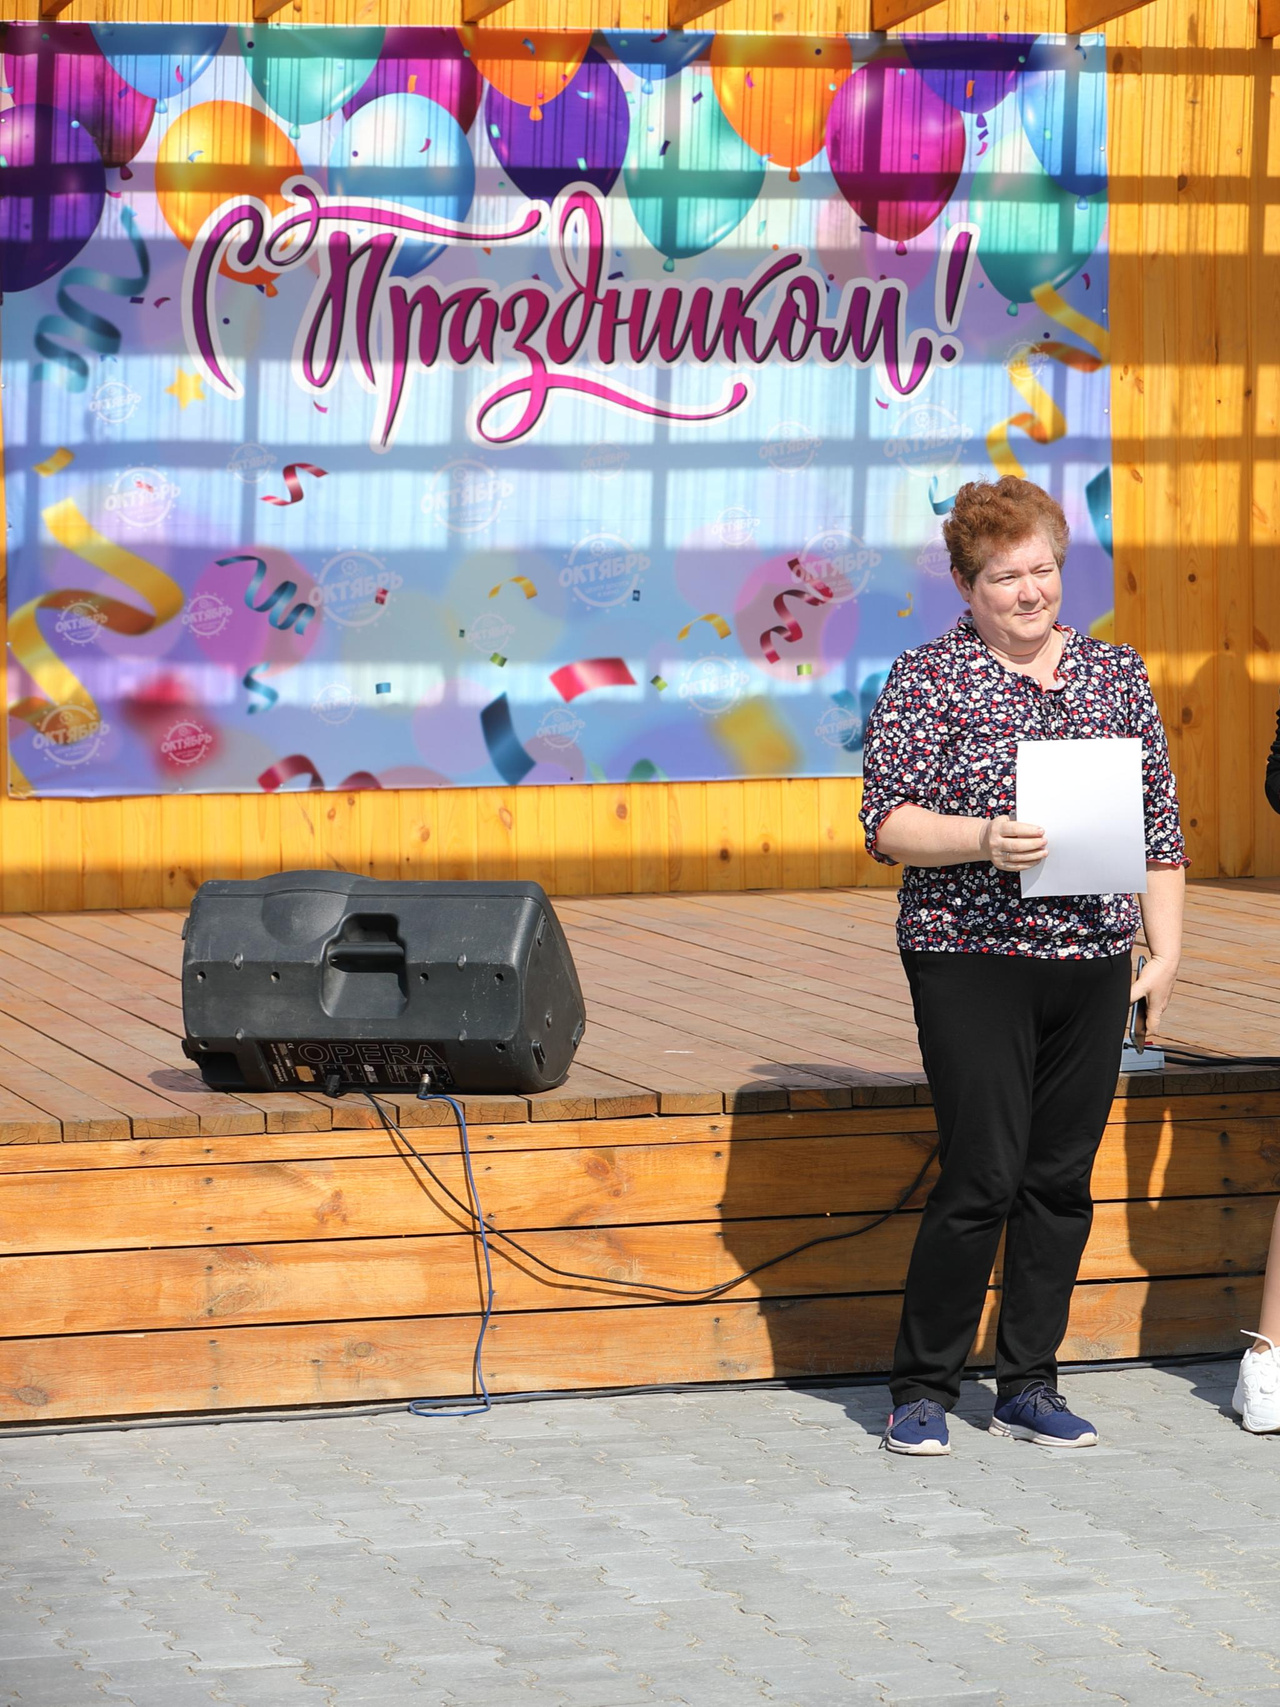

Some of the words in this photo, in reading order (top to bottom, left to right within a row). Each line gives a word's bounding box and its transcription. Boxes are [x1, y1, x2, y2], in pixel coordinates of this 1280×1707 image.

[192, 204, 263, 393] С
[264, 184, 973, 447] Праздником!
[759, 436, 823, 459] ОКТЯБРЬ
[883, 422, 973, 458] ОКТЯБРЬ
[104, 484, 181, 512] ОКТЯБРЬ
[420, 480, 514, 514] ОКТЯБРЬ
[559, 552, 651, 587] ОКТЯБРЬ
[791, 549, 882, 584] ОКТЯБРЬ
[308, 570, 403, 606] ОКТЯБРЬ
[55, 612, 108, 633] ОКТЯБРЬ
[182, 605, 233, 625] ОКТЯБРЬ
[678, 671, 749, 698] ОКТЯБРЬ
[32, 720, 110, 749] ОКТЯБРЬ
[537, 719, 586, 739] ОКТЯБРЬ
[161, 733, 212, 754] ОКТЯБРЬ
[298, 1043, 446, 1065] OPERA
